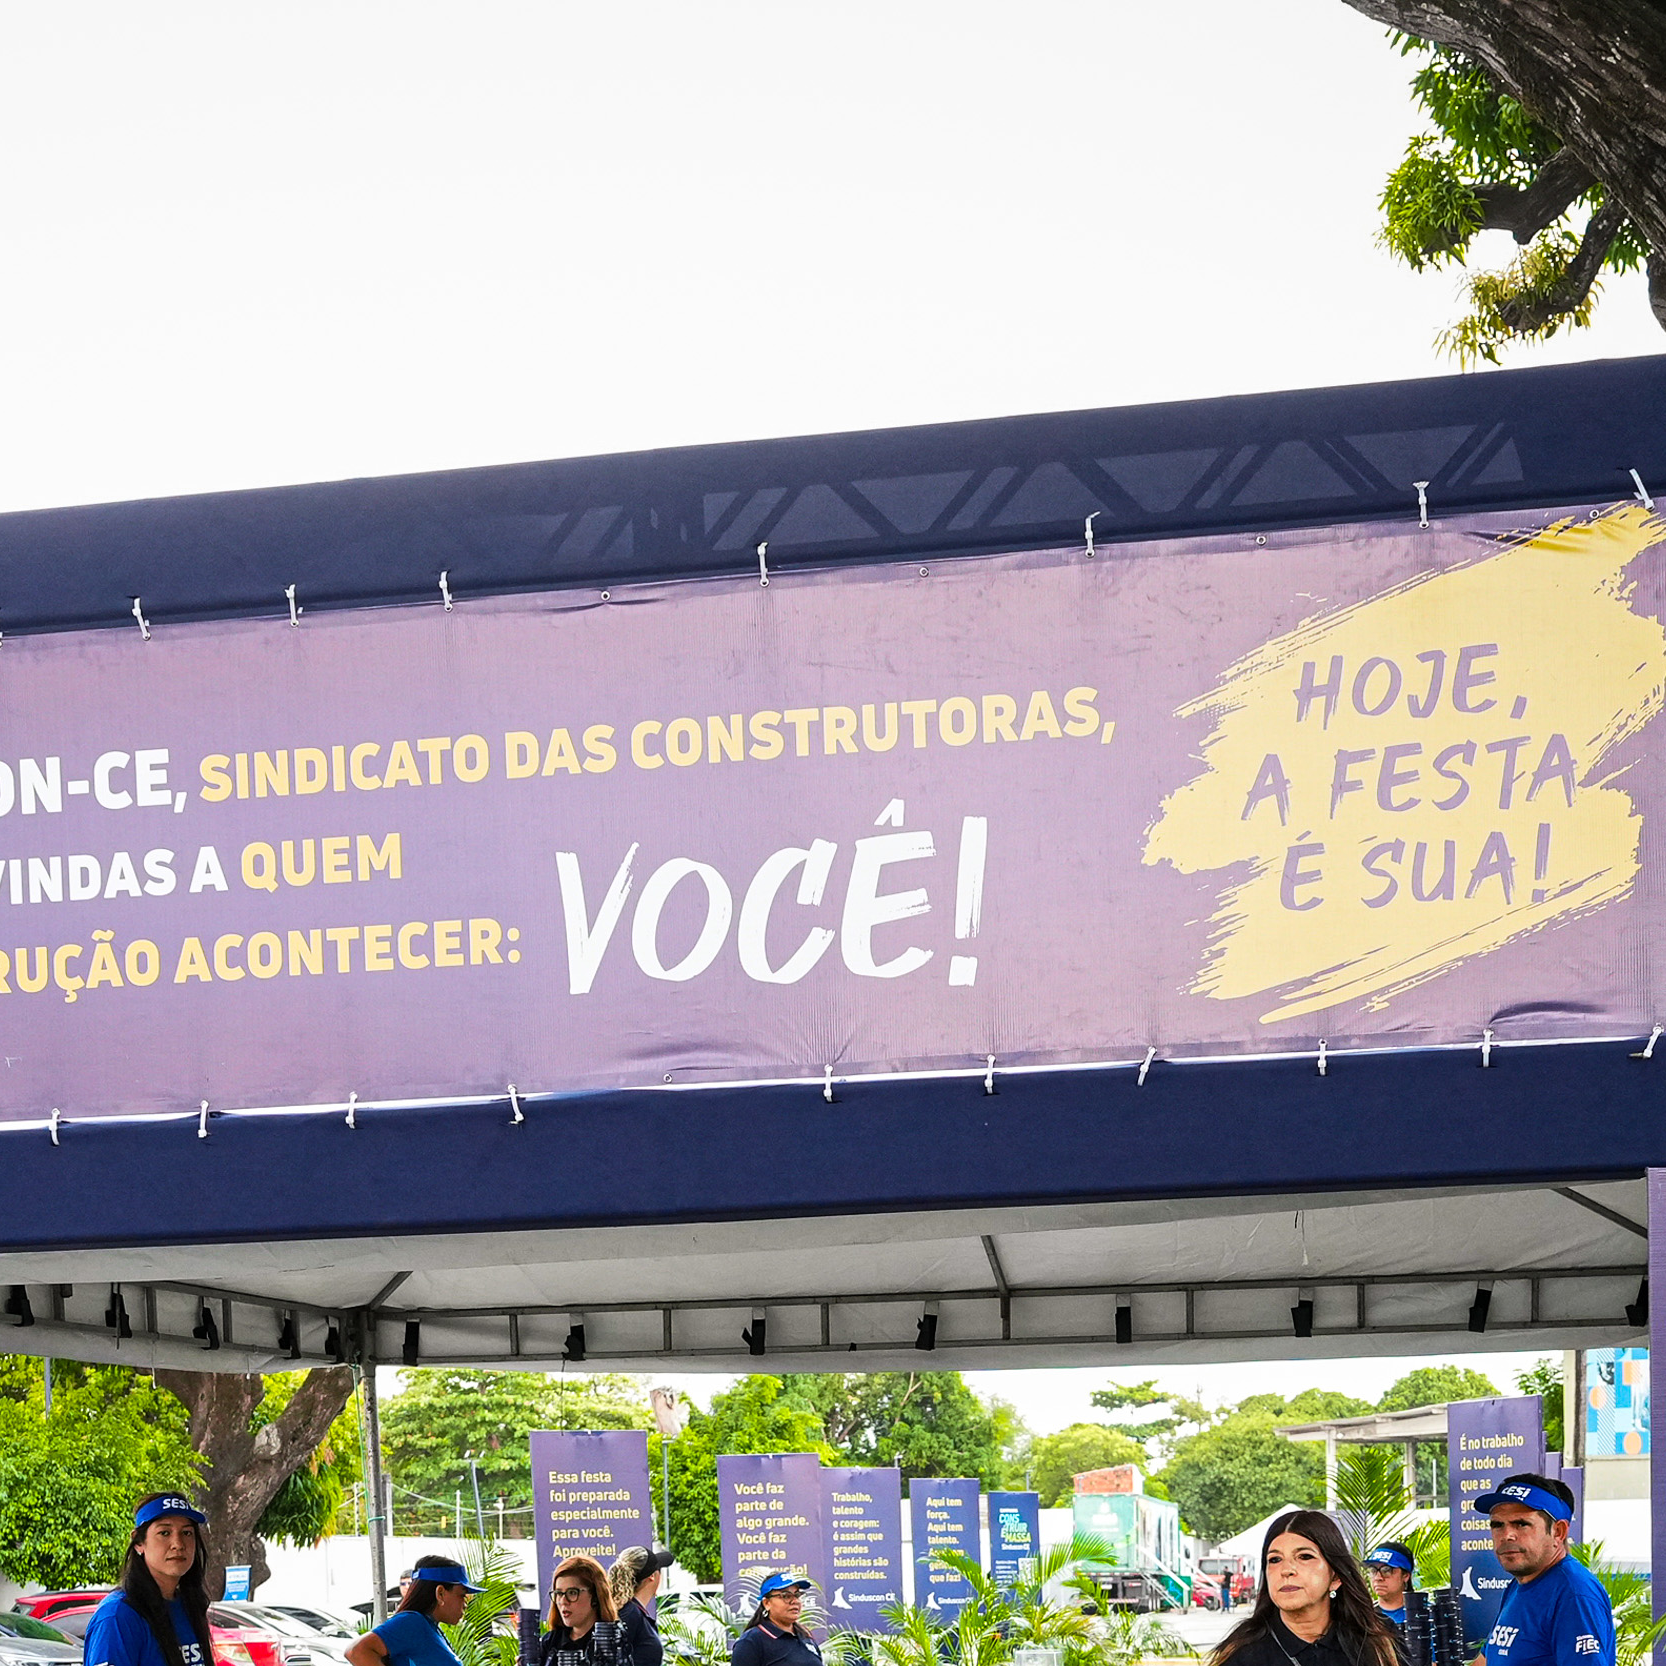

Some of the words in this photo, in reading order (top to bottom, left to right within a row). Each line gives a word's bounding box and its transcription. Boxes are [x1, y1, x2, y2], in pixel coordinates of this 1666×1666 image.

[1293, 642, 1529, 732] HOJE,
[198, 734, 491, 803] SINDICATO
[504, 722, 614, 780] DAS
[630, 686, 1116, 771] CONSTRUTORAS,
[1240, 768, 1295, 827] A
[1328, 733, 1580, 819] FESTA
[188, 846, 229, 894] A
[240, 833, 403, 892] QUEM
[1280, 832, 1327, 913] É
[1360, 822, 1552, 909] SUA!
[556, 799, 989, 996] VOCÊ!
[173, 916, 521, 986] ACONTECER:
[1460, 1434, 1467, 1451] É
[1468, 1438, 1481, 1450] no
[1482, 1433, 1524, 1449] trabalho
[1460, 1457, 1472, 1471] de
[1474, 1455, 1496, 1470] todo
[1497, 1454, 1513, 1468] dia
[549, 1471, 578, 1483] Essa
[581, 1470, 612, 1483] festa
[734, 1482, 765, 1495] Você
[766, 1482, 784, 1494] faz
[1460, 1480, 1478, 1494] que
[1480, 1478, 1492, 1490] as
[549, 1489, 566, 1502] foi
[569, 1488, 631, 1504] preparada
[832, 1492, 873, 1503] Trabalho,
[926, 1497, 945, 1508] Aqui
[946, 1498, 963, 1507] tem
[735, 1500, 767, 1514] parte
[769, 1499, 784, 1511] de
[832, 1506, 864, 1515] talento
[551, 1507, 640, 1523] especialmente
[736, 1516, 763, 1530] algo
[765, 1515, 809, 1530] grande.
[926, 1510, 950, 1521] força.
[839, 1520, 880, 1530] coragem:
[927, 1522, 946, 1533] Aqui
[947, 1522, 964, 1532] tem
[1461, 1516, 1490, 1531] coisas
[552, 1529, 580, 1542] para
[582, 1525, 614, 1539] você.
[737, 1532, 767, 1545] Você
[769, 1532, 787, 1543] faz
[833, 1531, 839, 1541] é
[840, 1532, 866, 1541] assim
[867, 1533, 884, 1542] que
[928, 1535, 960, 1544] talento.
[553, 1543, 616, 1559] Aproveite!
[738, 1549, 770, 1563] parte
[771, 1548, 787, 1560] da
[834, 1545, 869, 1556] grandes
[834, 1556, 872, 1567] histórias
[873, 1556, 889, 1567] são
[834, 1570, 887, 1580] construídas.
[848, 1593, 885, 1602] Sinduscon
[885, 1592, 896, 1601] CE
